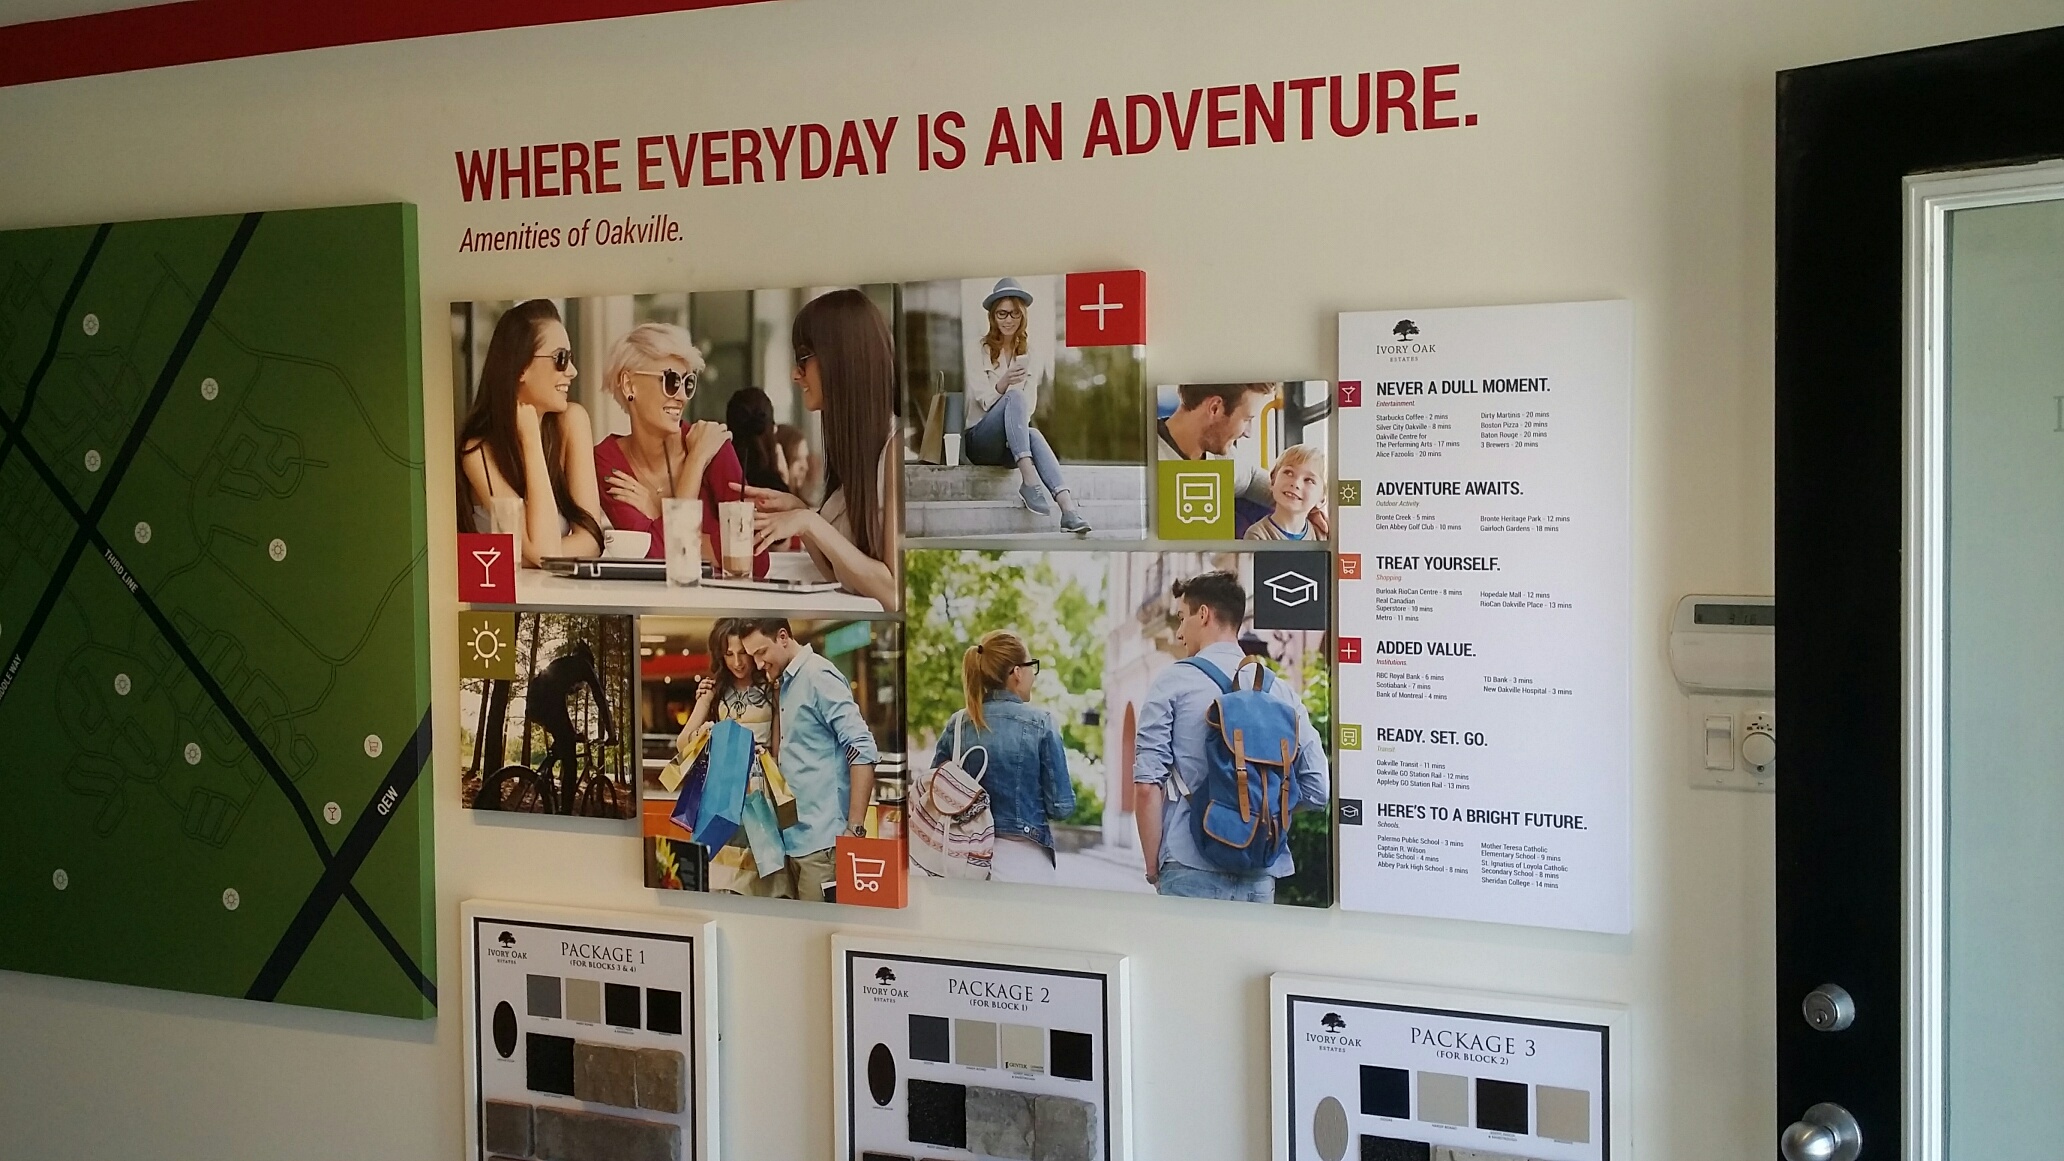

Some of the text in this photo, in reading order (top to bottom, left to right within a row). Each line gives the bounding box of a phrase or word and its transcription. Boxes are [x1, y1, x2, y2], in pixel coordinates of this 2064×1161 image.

[455, 63, 1479, 202] WHERE EVERYDAY IS AN ADVENTURE.
[458, 214, 683, 253] Amenities of Oakville.
[1376, 343, 1436, 355] IVORY OAK
[1377, 377, 1550, 396] NEVER A DULL MOMENT.
[1405, 413, 1425, 421] Coffee
[1480, 412, 1496, 420] Dirty
[1392, 423, 1404, 432] City
[1405, 423, 1428, 431] Oakville
[1375, 433, 1398, 441] Oakville
[1499, 431, 1519, 439] Rouge
[1387, 441, 1420, 449] Performing
[1376, 481, 1524, 496] ADVENTURE AWAITS.
[1375, 513, 1412, 521] Bronte Creek
[1501, 515, 1527, 523] Heritage
[1389, 523, 1408, 531] Abbey
[1376, 556, 1501, 571] TREAT YOURSELF.
[105, 548, 139, 593] THIRD LINE
[1419, 588, 1439, 596] Centre
[1480, 591, 1508, 599] Hopedale
[1376, 604, 1407, 612] Superstore
[1376, 640, 1476, 657] ADDED VALUE.
[9, 653, 22, 674] WAY
[1389, 672, 1405, 681] Royal
[1376, 681, 1407, 689] Scotiabank
[1376, 690, 1391, 698] Bank
[1522, 687, 1547, 696] Hospital
[1377, 727, 1488, 746] READY. SET. GO.
[1376, 759, 1399, 767] Oakville
[1376, 768, 1399, 776] Oakville
[1409, 770, 1430, 778] Station
[1431, 771, 1442, 779] Rail
[1376, 778, 1399, 787] Appleby
[1400, 779, 1409, 787] GO
[1410, 780, 1431, 788] Station
[377, 785, 399, 816] QEW
[1377, 803, 1588, 830] HERE'S TO A BRIGHT FUTURE.
[1377, 834, 1440, 846] Palermo Public School
[1377, 844, 1426, 854] Captain Wilson
[1480, 842, 1548, 854] Mother Teresa Catholic
[1377, 851, 1416, 861] Public School
[1480, 849, 1536, 860] Elementary School
[1377, 861, 1445, 872] Abbey Park High School
[1490, 860, 1515, 868] Ignatius
[1523, 862, 1543, 871] Loyola
[1543, 864, 1568, 872] Catholic
[1481, 867, 1534, 878] Secondary School
[1481, 876, 1531, 888] Sheridan College
[488, 948, 528, 960] IVORY OAK
[561, 941, 645, 964] PACKAGE 1
[569, 959, 587, 968] (FOR
[588, 961, 615, 971] BLOCKS
[863, 985, 909, 998] IVORY OAK
[949, 978, 1050, 1003] PACKAGE 2
[969, 999, 990, 1008] (FOR
[991, 1001, 1020, 1011] BLOCK
[1306, 1032, 1362, 1047] IVORY OAK
[1411, 1027, 1536, 1057] PACKAGE 3
[1436, 1050, 1461, 1060] (FOR
[1463, 1053, 1498, 1064] BLOCK
